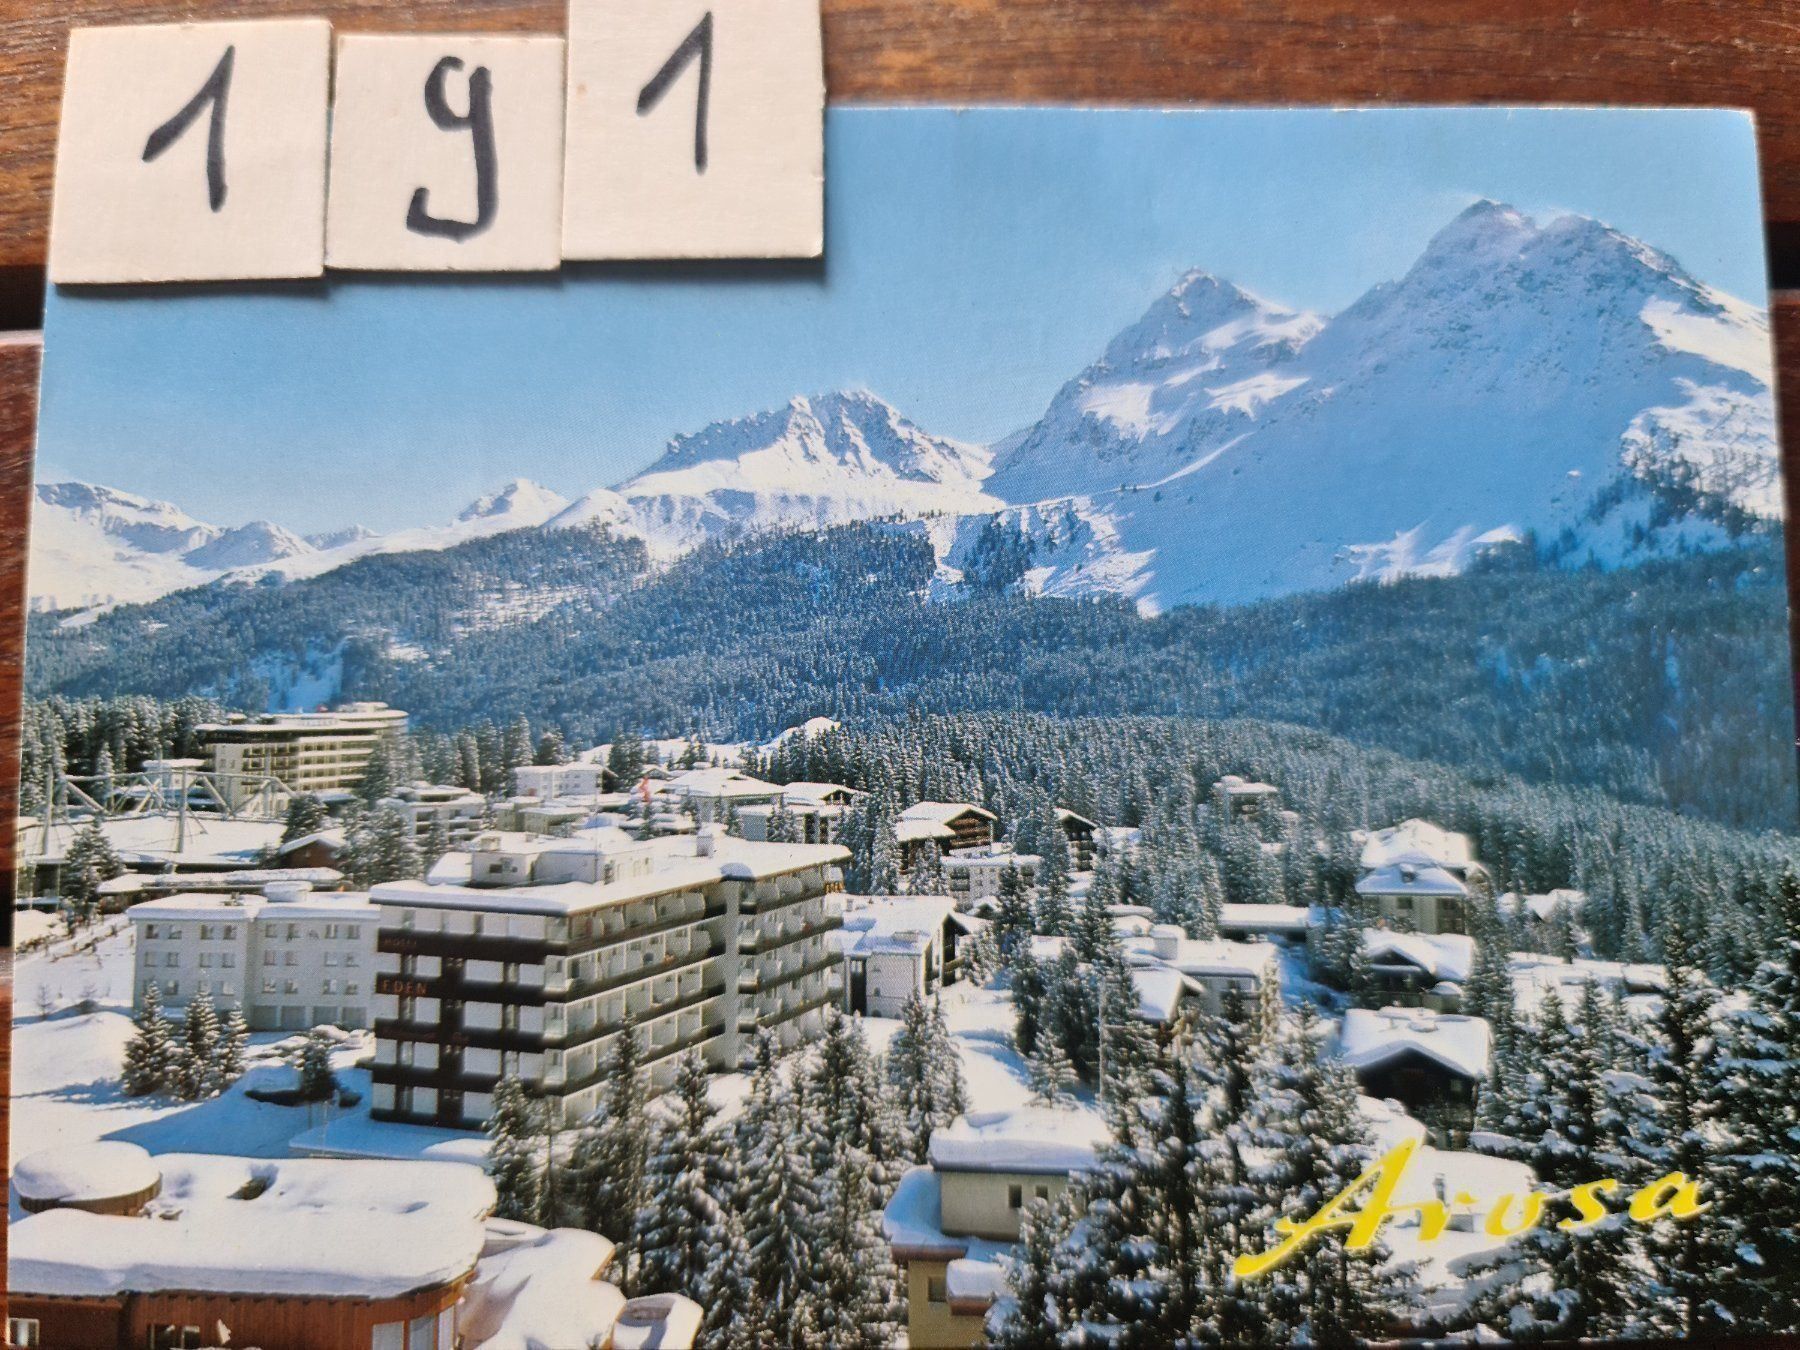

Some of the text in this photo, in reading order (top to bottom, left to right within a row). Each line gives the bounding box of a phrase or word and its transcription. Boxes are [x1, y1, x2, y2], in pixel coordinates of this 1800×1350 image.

[142, 46, 233, 212] 1
[637, 12, 712, 171] 1
[382, 979, 428, 996] EDEN
[1232, 1136, 1713, 1278] Arosa
